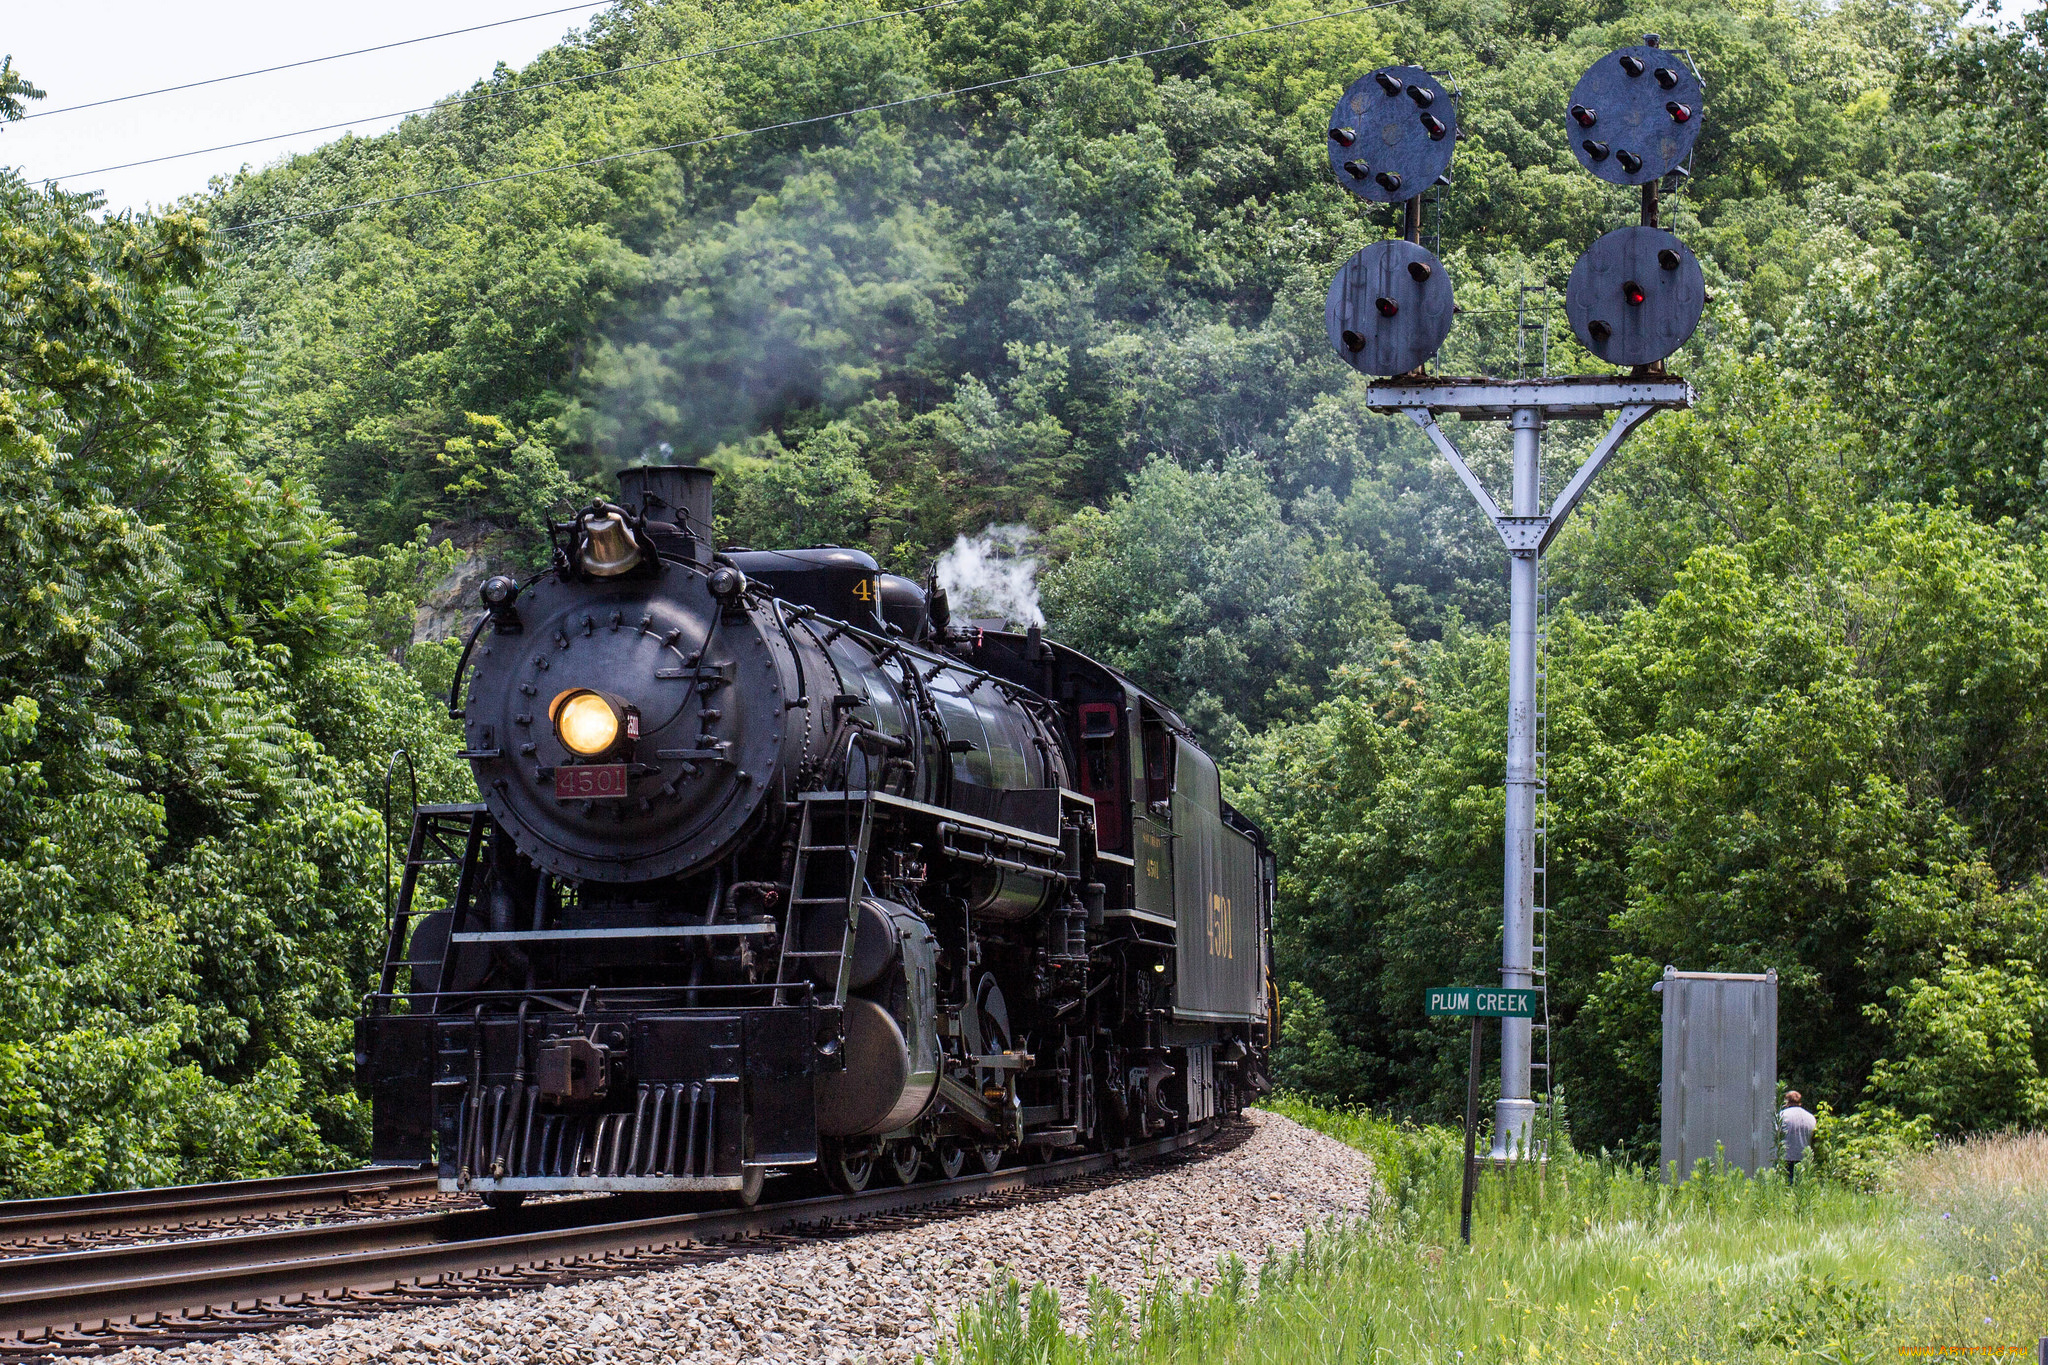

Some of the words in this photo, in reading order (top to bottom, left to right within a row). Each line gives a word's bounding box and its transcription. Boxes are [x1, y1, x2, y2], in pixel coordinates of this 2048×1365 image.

[560, 770, 622, 792] 4501
[1206, 891, 1233, 959] 4501
[1431, 993, 1469, 1010] PLUM
[1476, 993, 1528, 1012] CREEK
